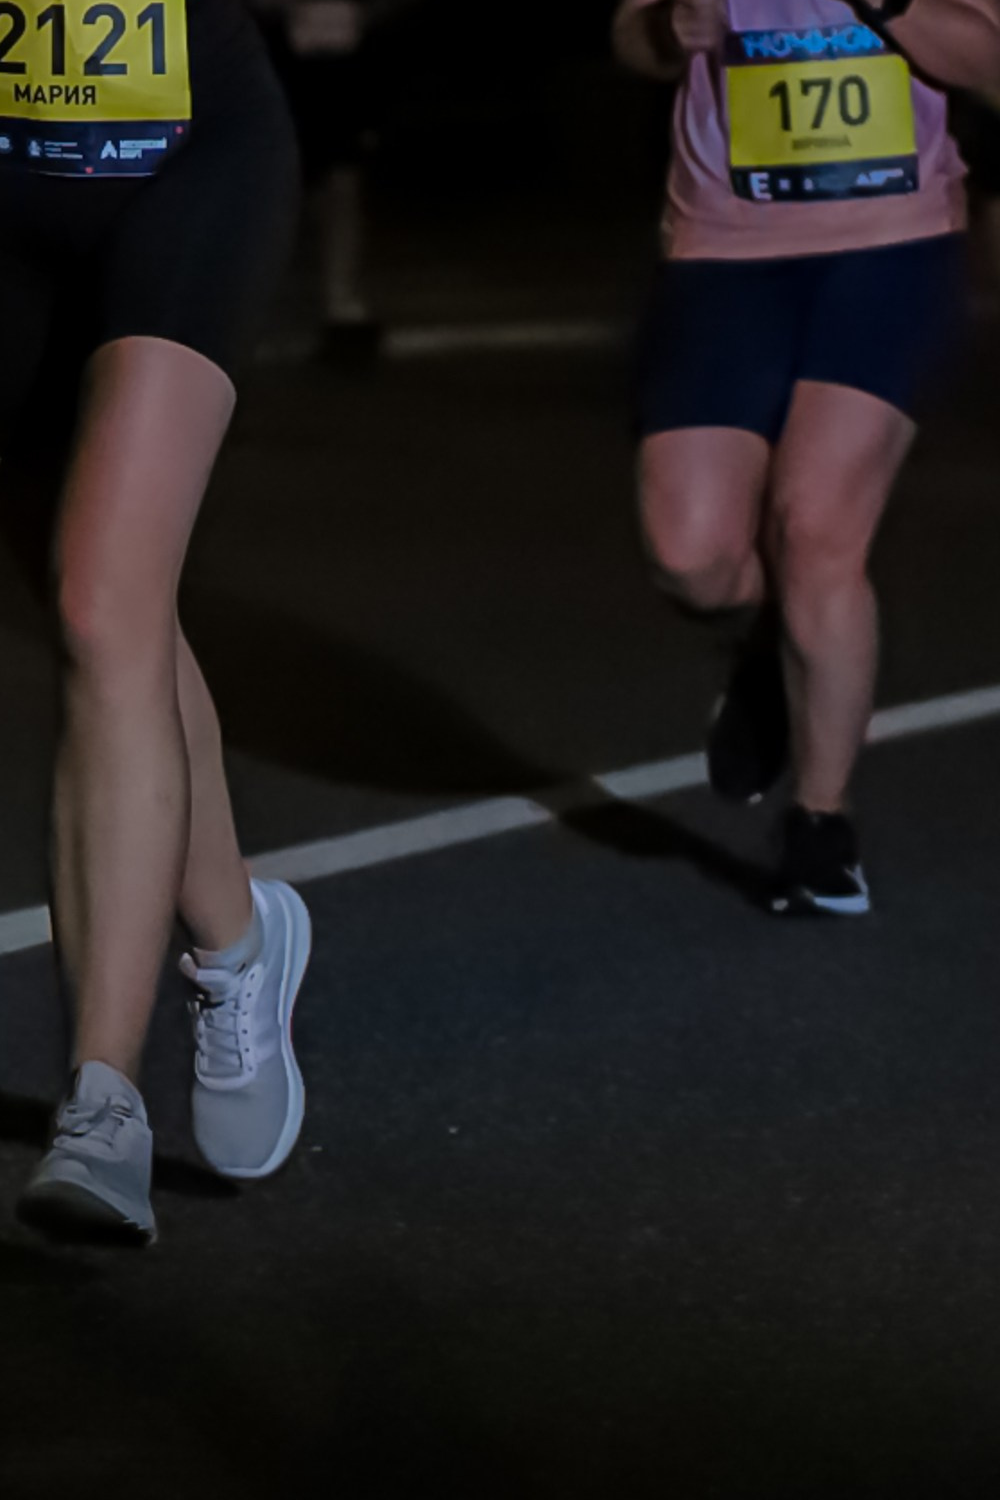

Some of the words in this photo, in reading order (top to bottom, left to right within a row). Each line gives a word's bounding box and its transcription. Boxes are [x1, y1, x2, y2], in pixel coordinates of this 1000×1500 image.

[14, 83, 97, 105] МАРИЯ
[769, 75, 870, 131] 170
[750, 171, 773, 201] E
